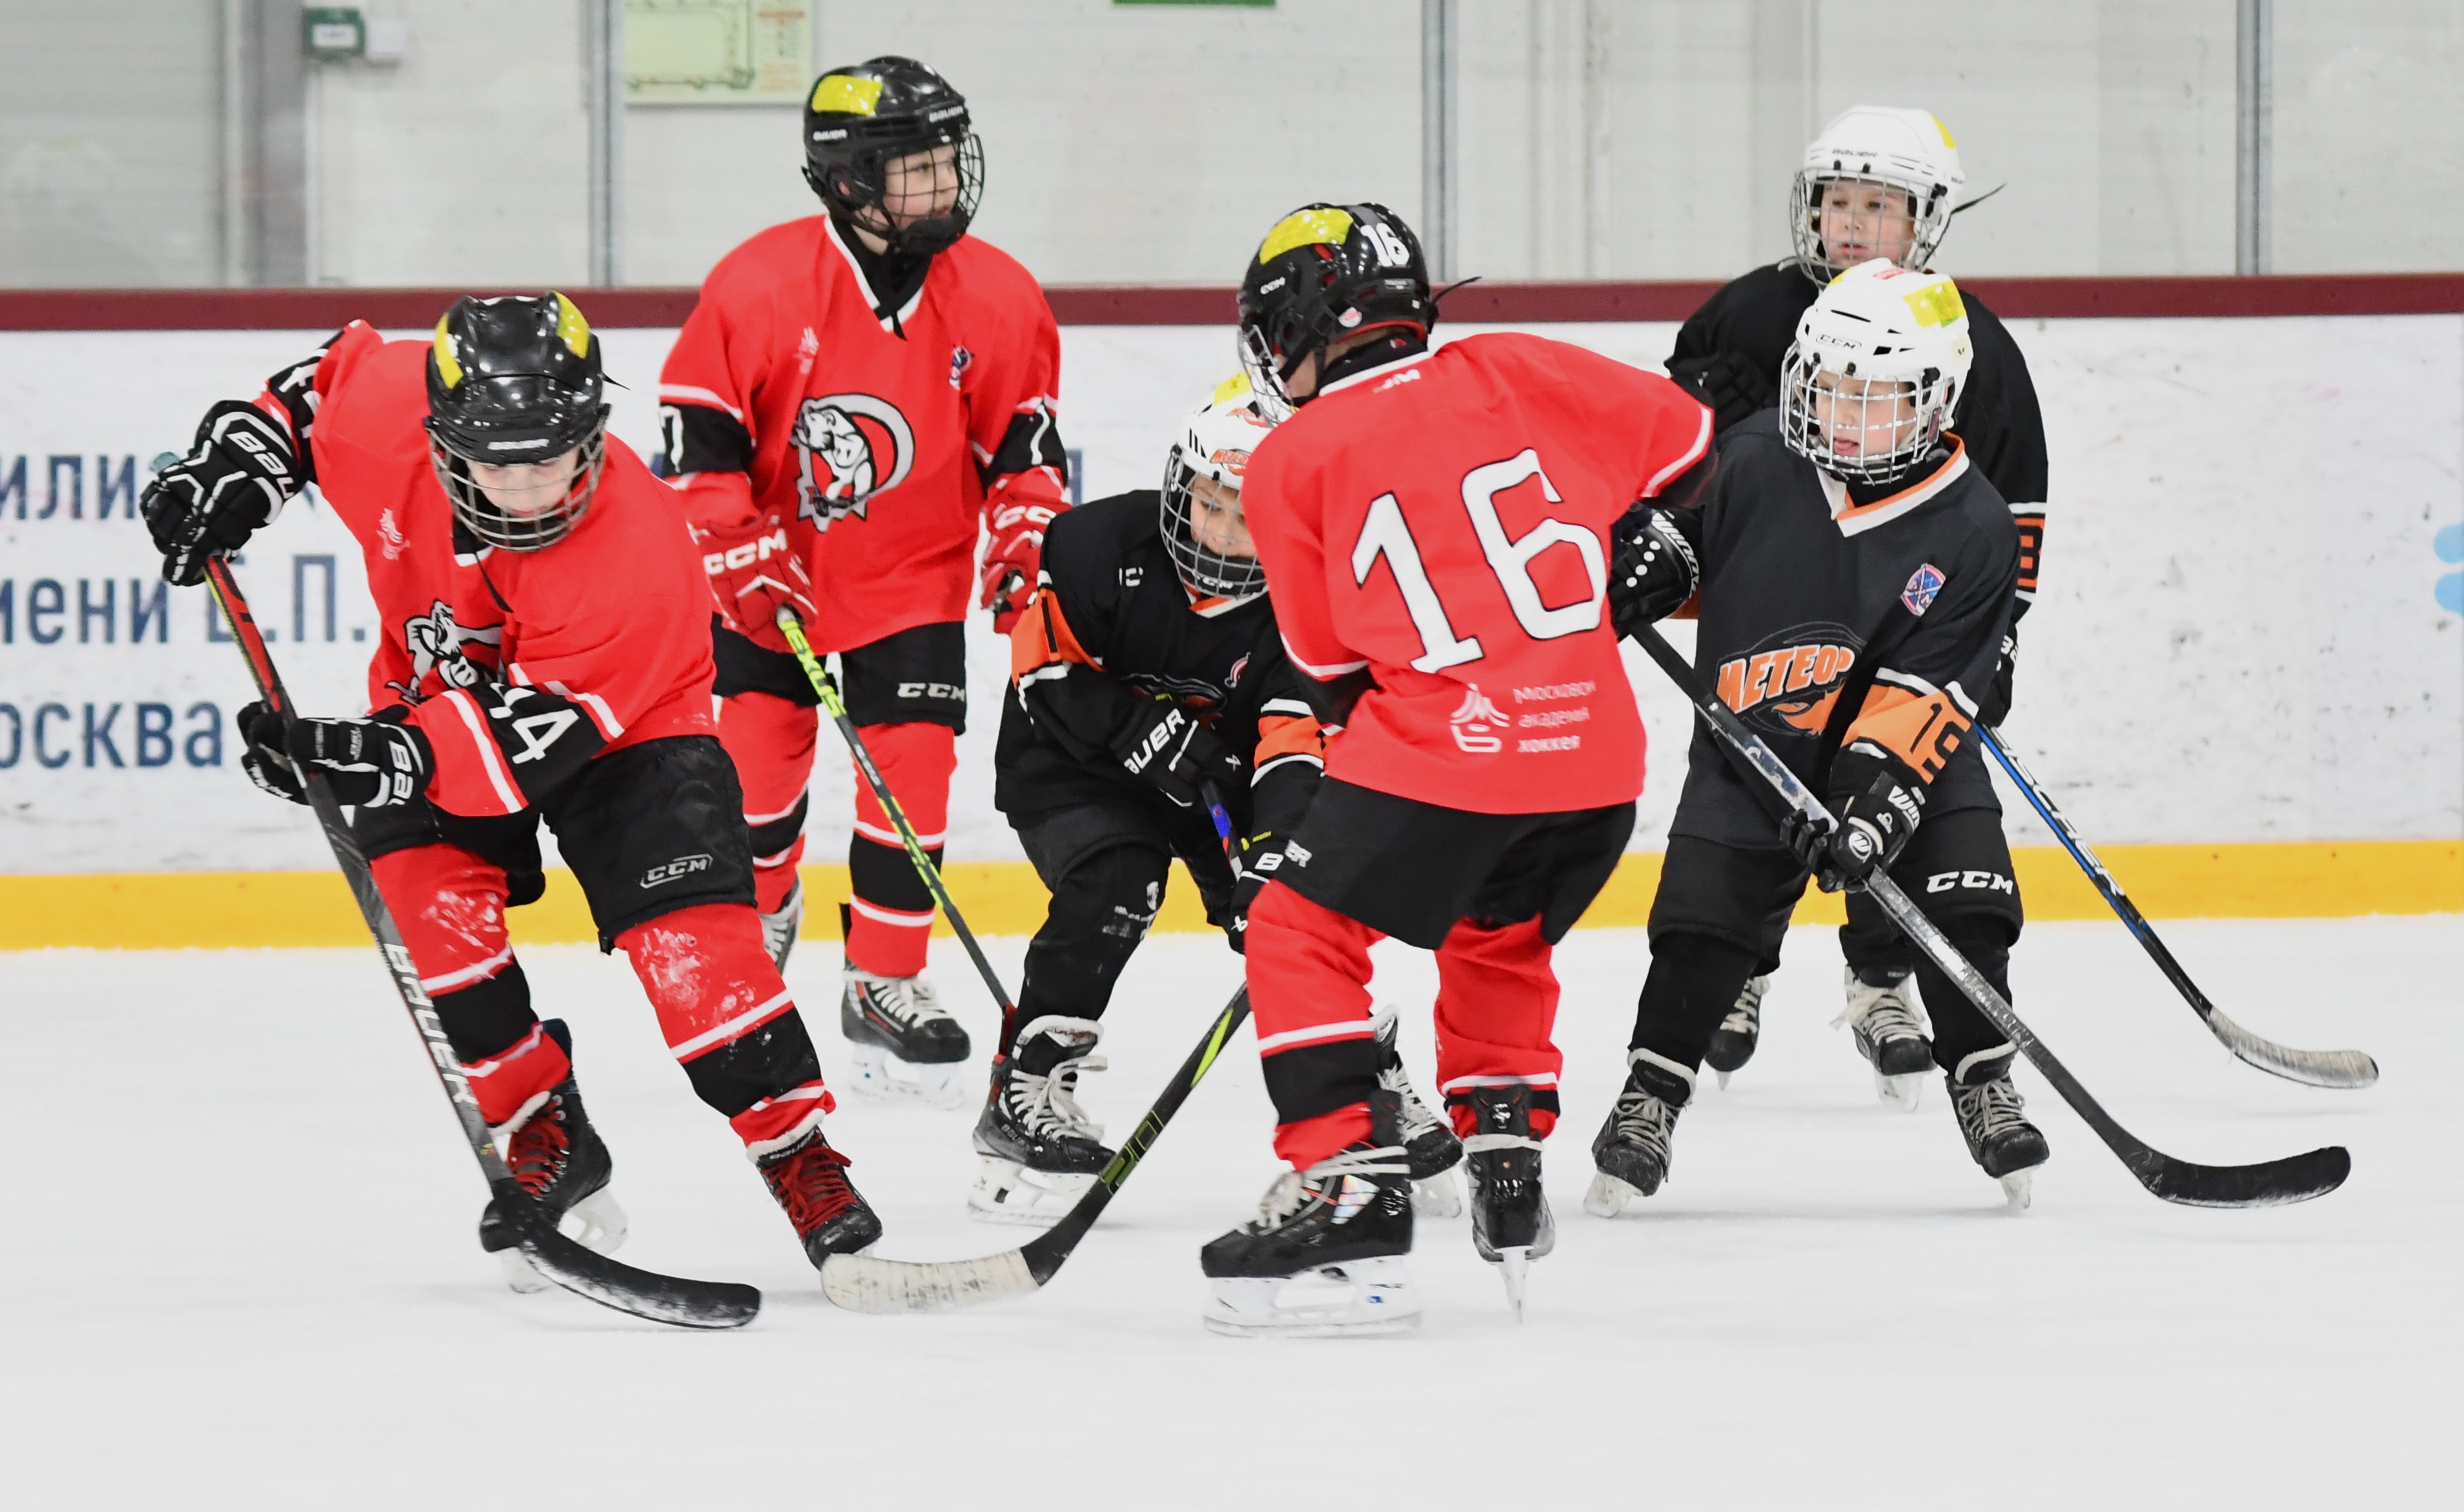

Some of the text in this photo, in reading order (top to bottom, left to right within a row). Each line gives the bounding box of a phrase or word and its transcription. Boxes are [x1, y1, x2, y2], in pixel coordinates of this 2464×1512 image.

[1360, 223, 1410, 267] 16
[1820, 334, 1857, 349] CCM
[1352, 447, 1607, 674] 16
[646, 858, 708, 882] CCM
[1926, 870, 2013, 896] CCM
[384, 943, 479, 1105] BAUER
